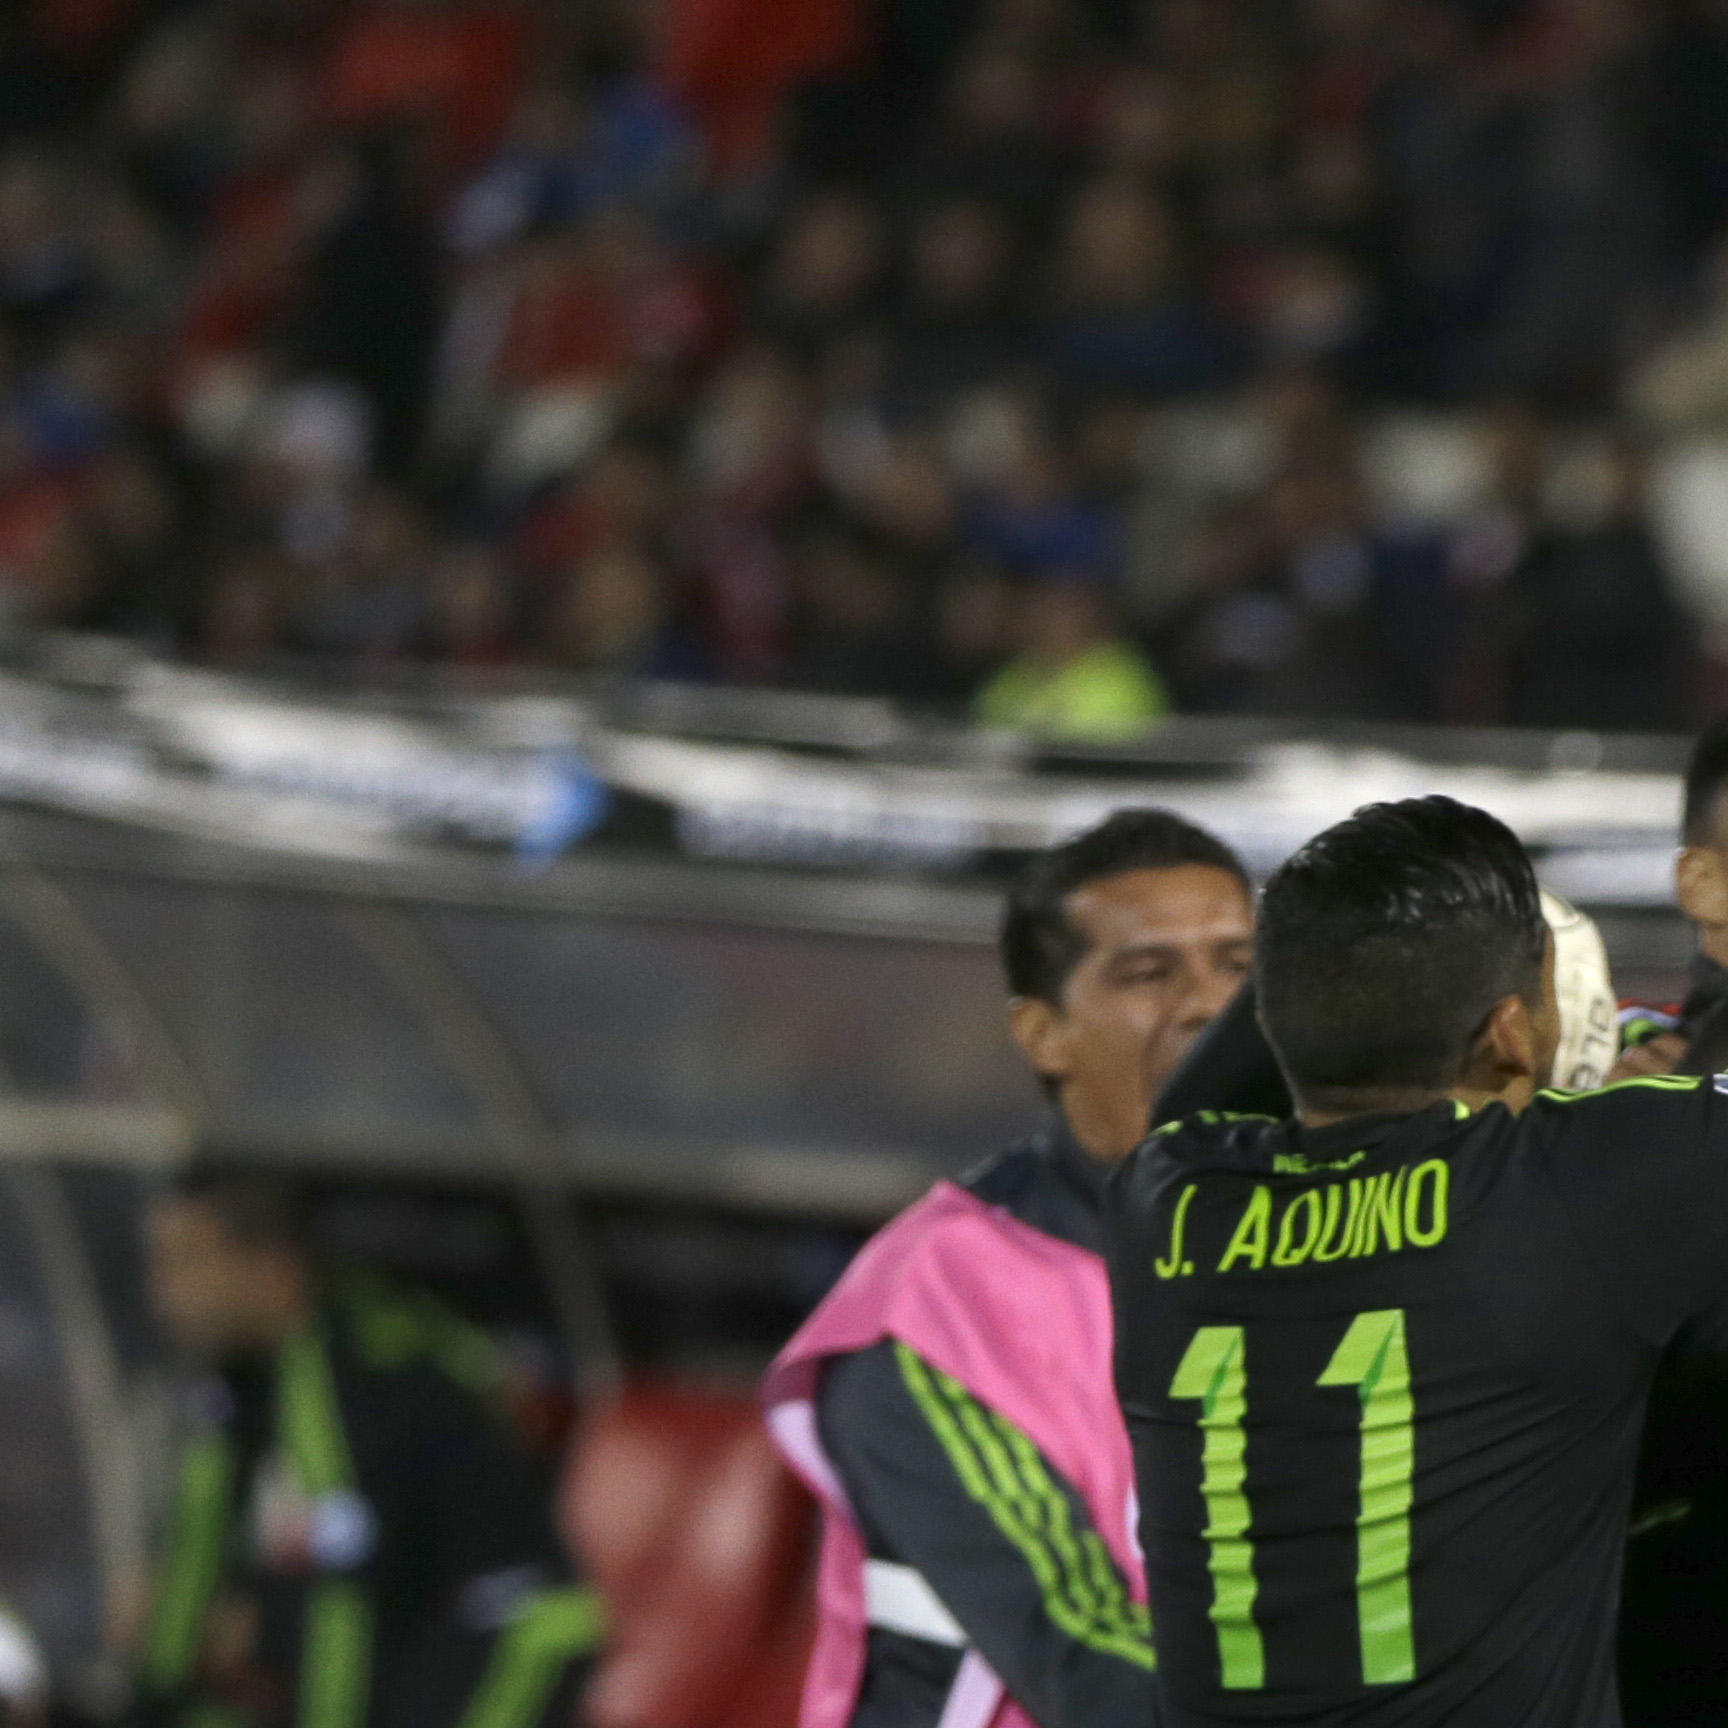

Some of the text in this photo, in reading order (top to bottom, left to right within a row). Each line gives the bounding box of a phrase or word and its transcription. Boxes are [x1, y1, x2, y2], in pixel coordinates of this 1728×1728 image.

[1154, 1158, 1449, 1279] J. AQUINO
[1168, 1308, 1416, 1690] 11
